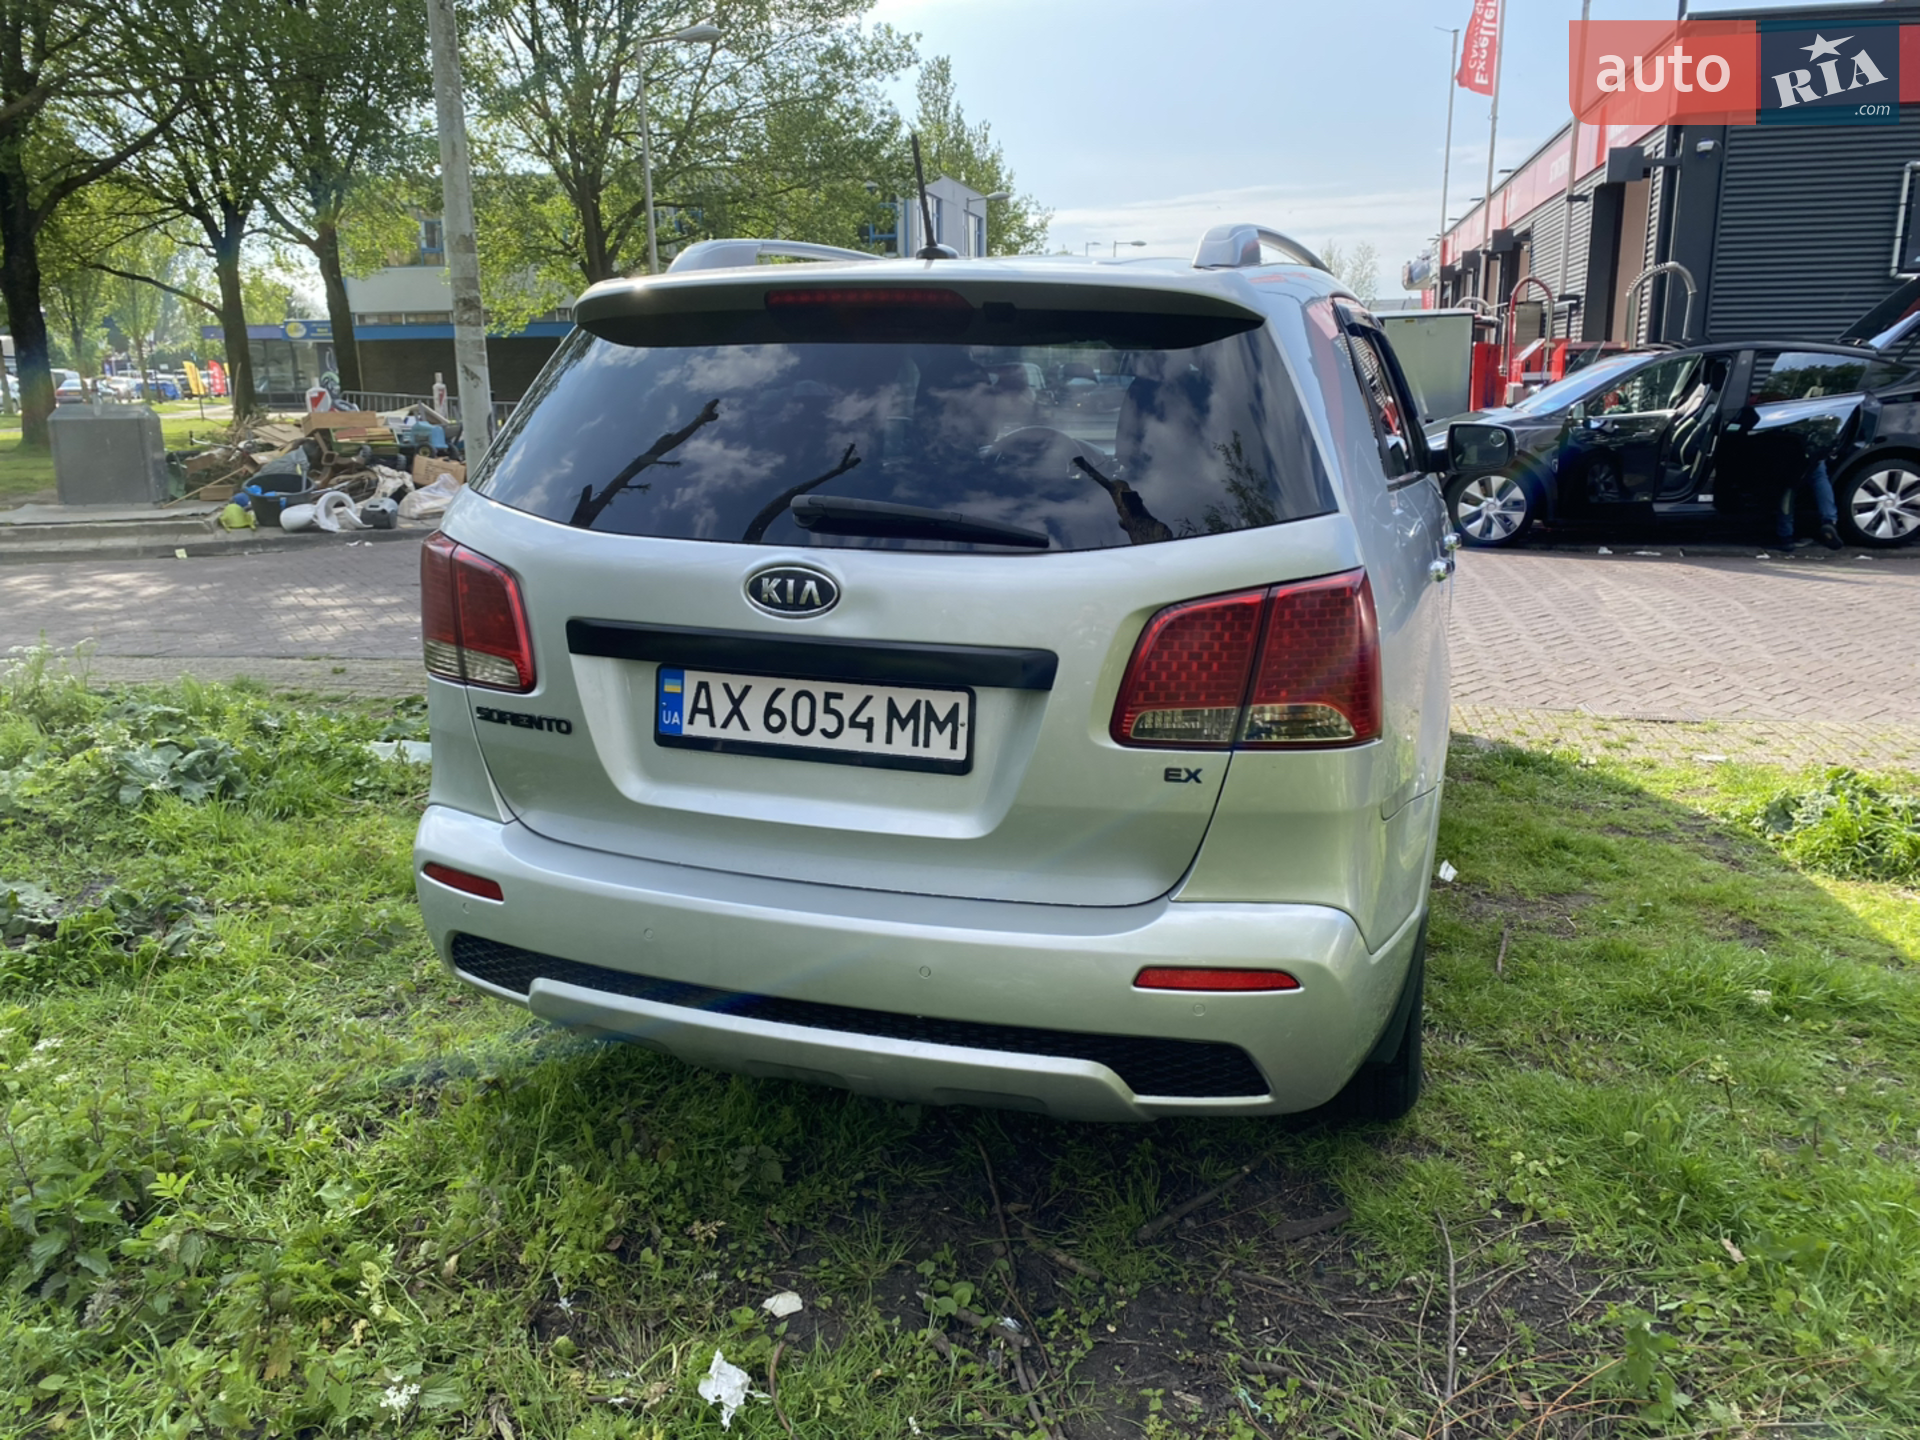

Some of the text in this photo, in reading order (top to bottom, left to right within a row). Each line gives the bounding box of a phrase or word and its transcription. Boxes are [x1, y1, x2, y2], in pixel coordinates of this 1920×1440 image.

[761, 577, 822, 606] KIA
[476, 706, 573, 736] SORENTO
[662, 710, 681, 726] UA
[687, 680, 961, 751] AX 6054 MM
[1163, 761, 1204, 785] EX
